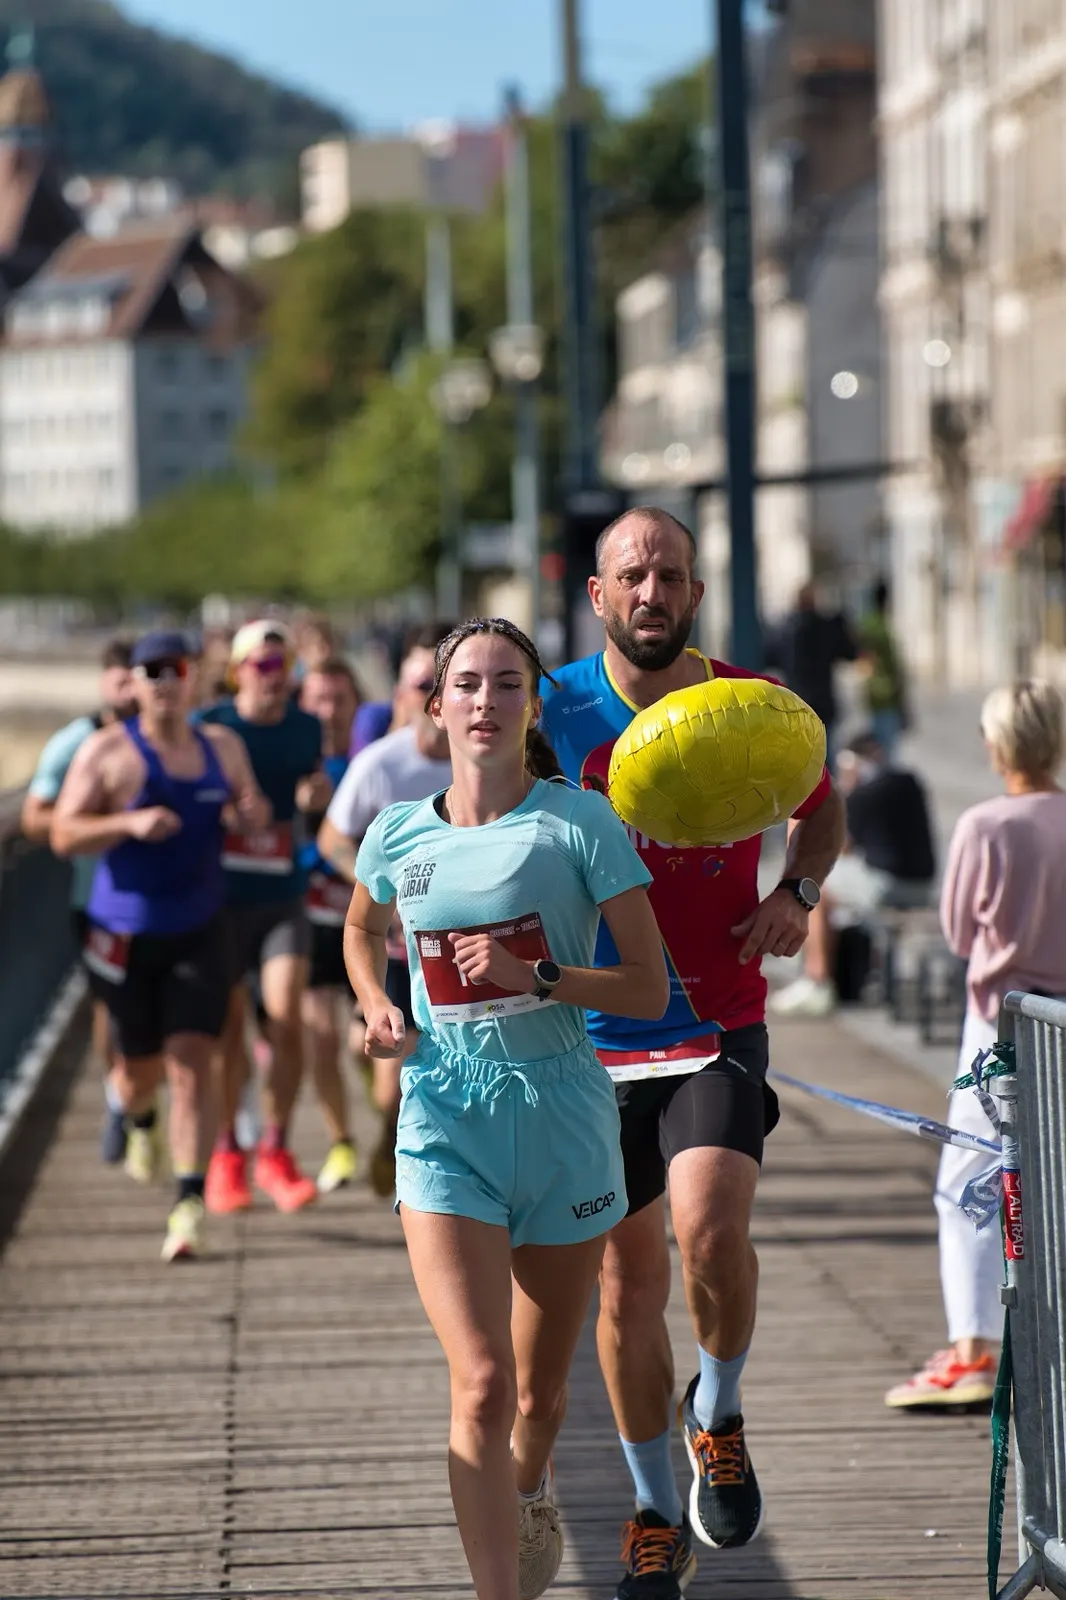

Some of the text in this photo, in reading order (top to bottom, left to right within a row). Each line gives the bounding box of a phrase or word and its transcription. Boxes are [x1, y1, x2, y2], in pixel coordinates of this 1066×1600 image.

[404, 862, 436, 879] CLES
[649, 1050, 667, 1059] PAUL
[572, 1191, 615, 1220] VELCAP
[1009, 1195, 1025, 1256] ALTRAD
